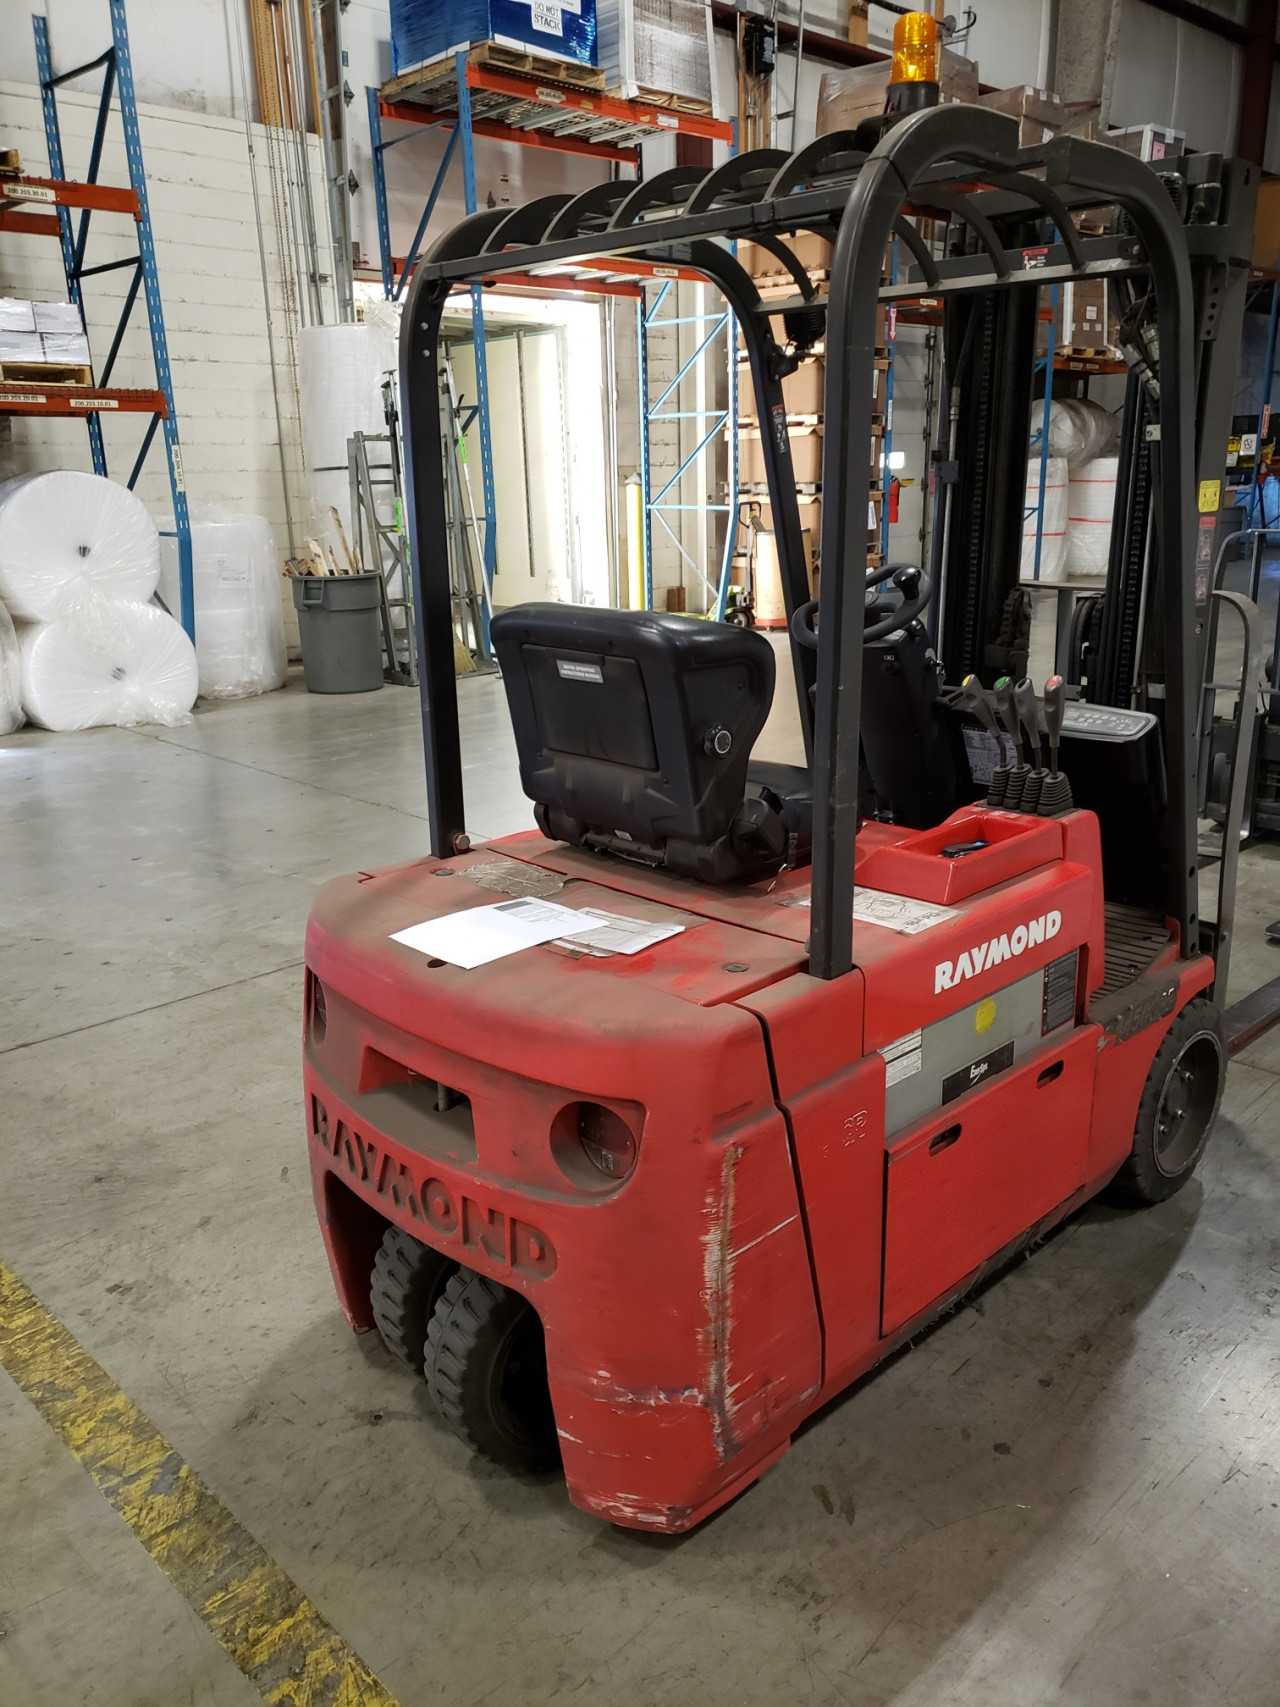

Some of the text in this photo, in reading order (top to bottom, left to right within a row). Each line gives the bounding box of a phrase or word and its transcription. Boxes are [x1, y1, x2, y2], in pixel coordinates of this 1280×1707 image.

[534, 2, 560, 17] DO NOT
[534, 13, 561, 30] STACK
[934, 910, 1062, 995] RAYMOND
[311, 1093, 559, 1281] RAYMOND
